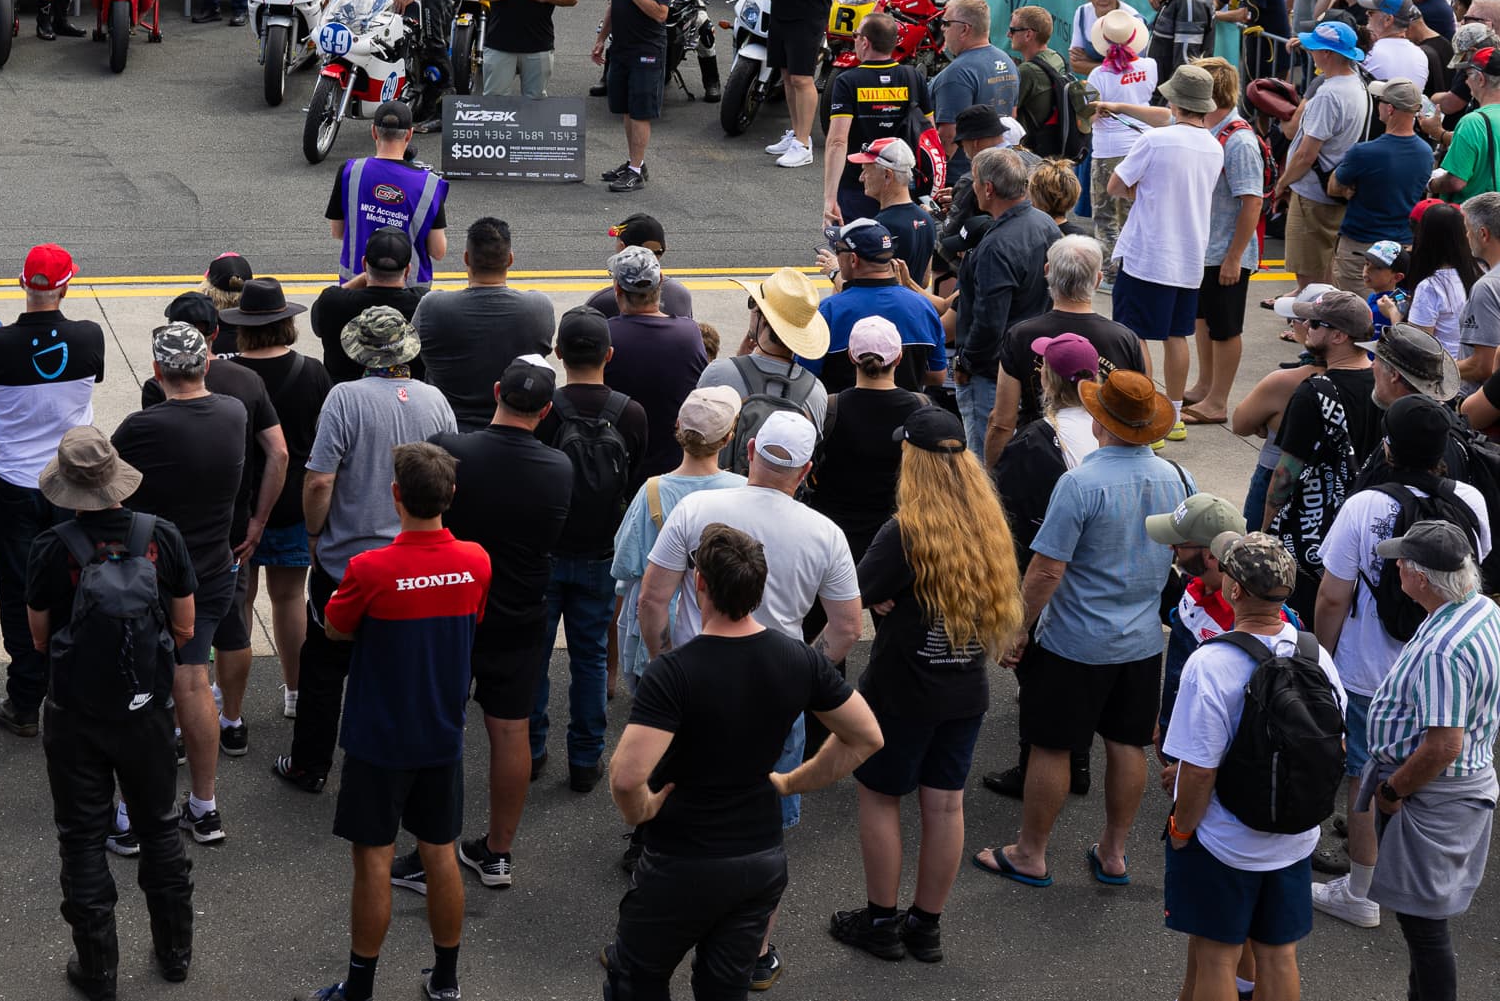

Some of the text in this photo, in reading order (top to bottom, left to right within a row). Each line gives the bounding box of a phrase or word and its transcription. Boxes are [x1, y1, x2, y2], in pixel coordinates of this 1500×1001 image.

[835, 7, 857, 32] R
[321, 26, 349, 55] 39
[1120, 71, 1147, 85] GIVI
[454, 110, 517, 122] NZSBK
[452, 130, 578, 141] 3509 4362 7689 7543
[451, 142, 506, 160] $5000
[361, 203, 409, 222] MNZ Accredited
[366, 213, 403, 228] Media 2026
[396, 571, 475, 591] HONDA
